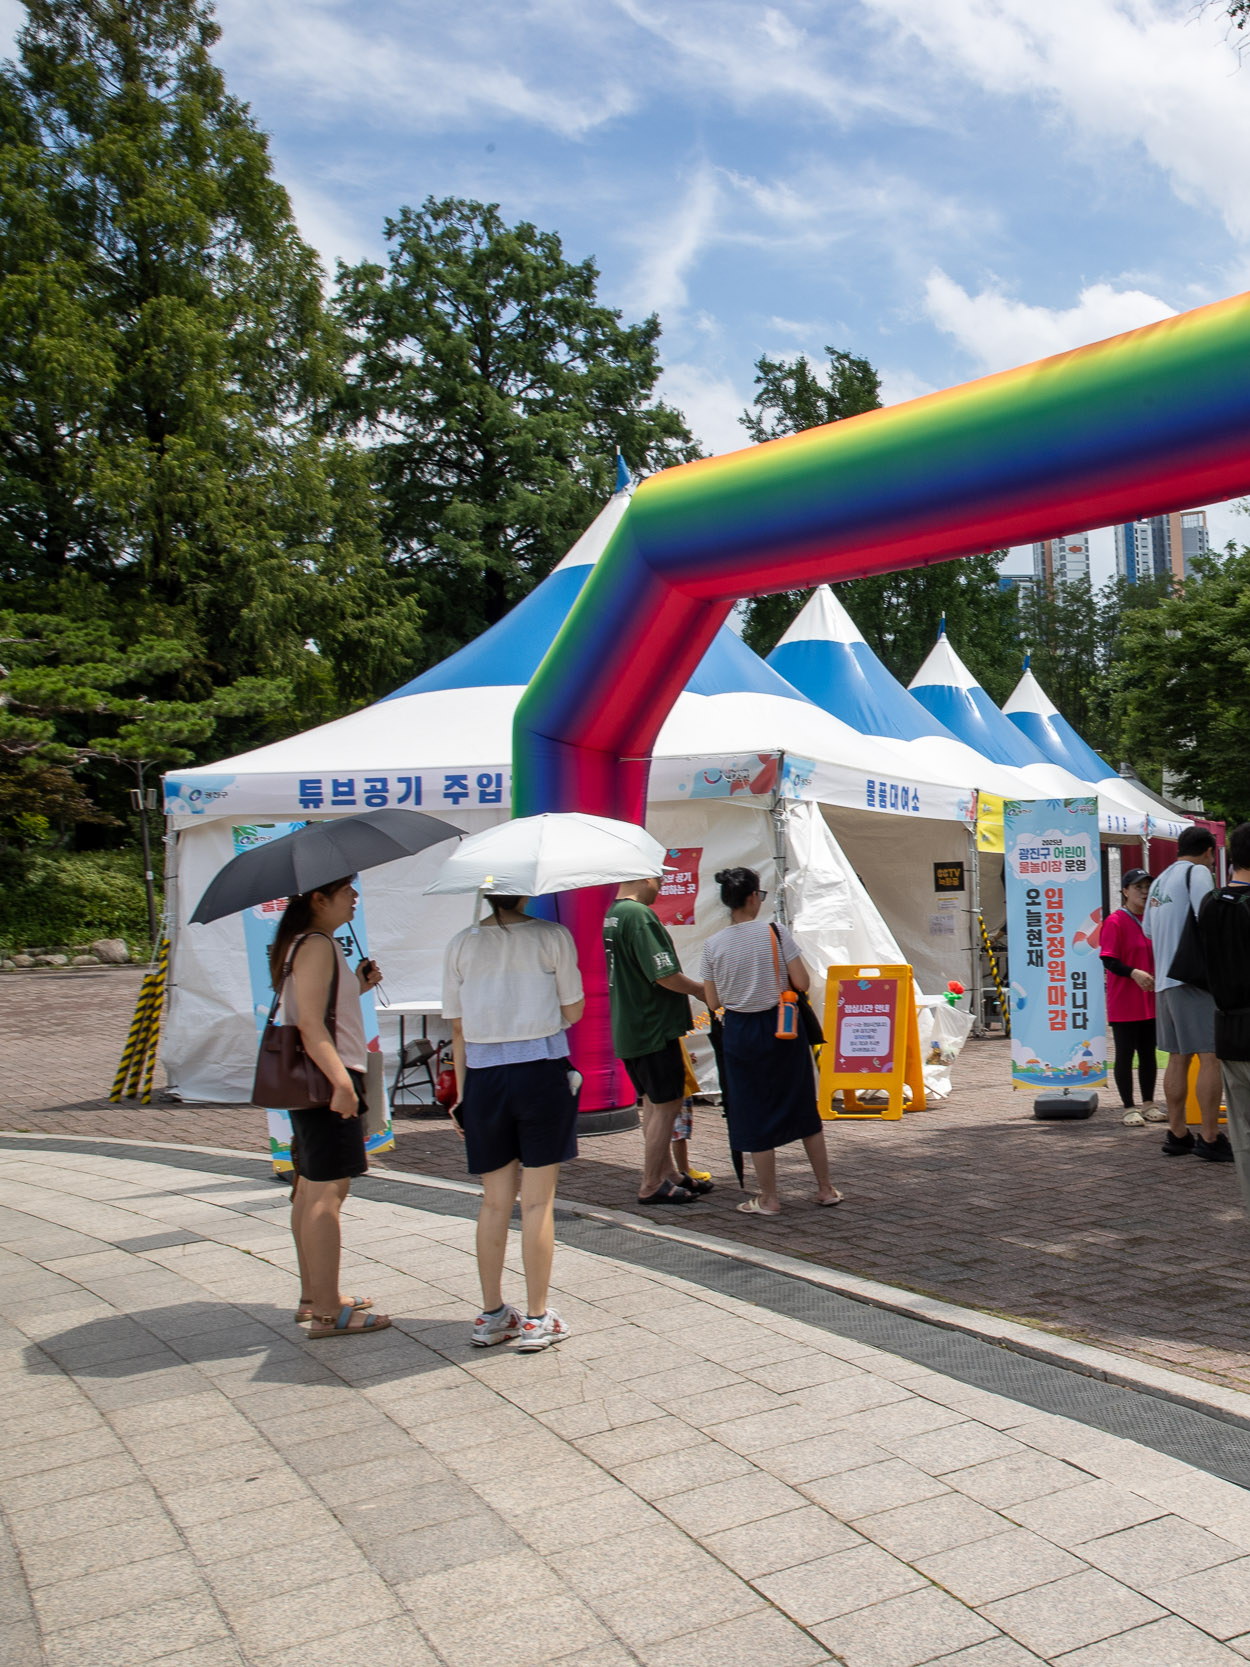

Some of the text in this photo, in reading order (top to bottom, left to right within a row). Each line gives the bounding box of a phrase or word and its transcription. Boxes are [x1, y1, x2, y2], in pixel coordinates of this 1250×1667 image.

[205, 791, 228, 799] 광진구
[298, 773, 513, 809] 튜브공기 주입
[867, 779, 920, 812] 물품대여소
[1018, 846, 1086, 860] 광진구 어린이
[937, 868, 960, 877] CCTV
[1019, 859, 1086, 874] 물놀이장 운영
[675, 872, 692, 883] 공기
[658, 883, 696, 896] 입하는 곳
[1070, 971, 1089, 1030] 입니다
[844, 1004, 890, 1014] 점심시간 안내
